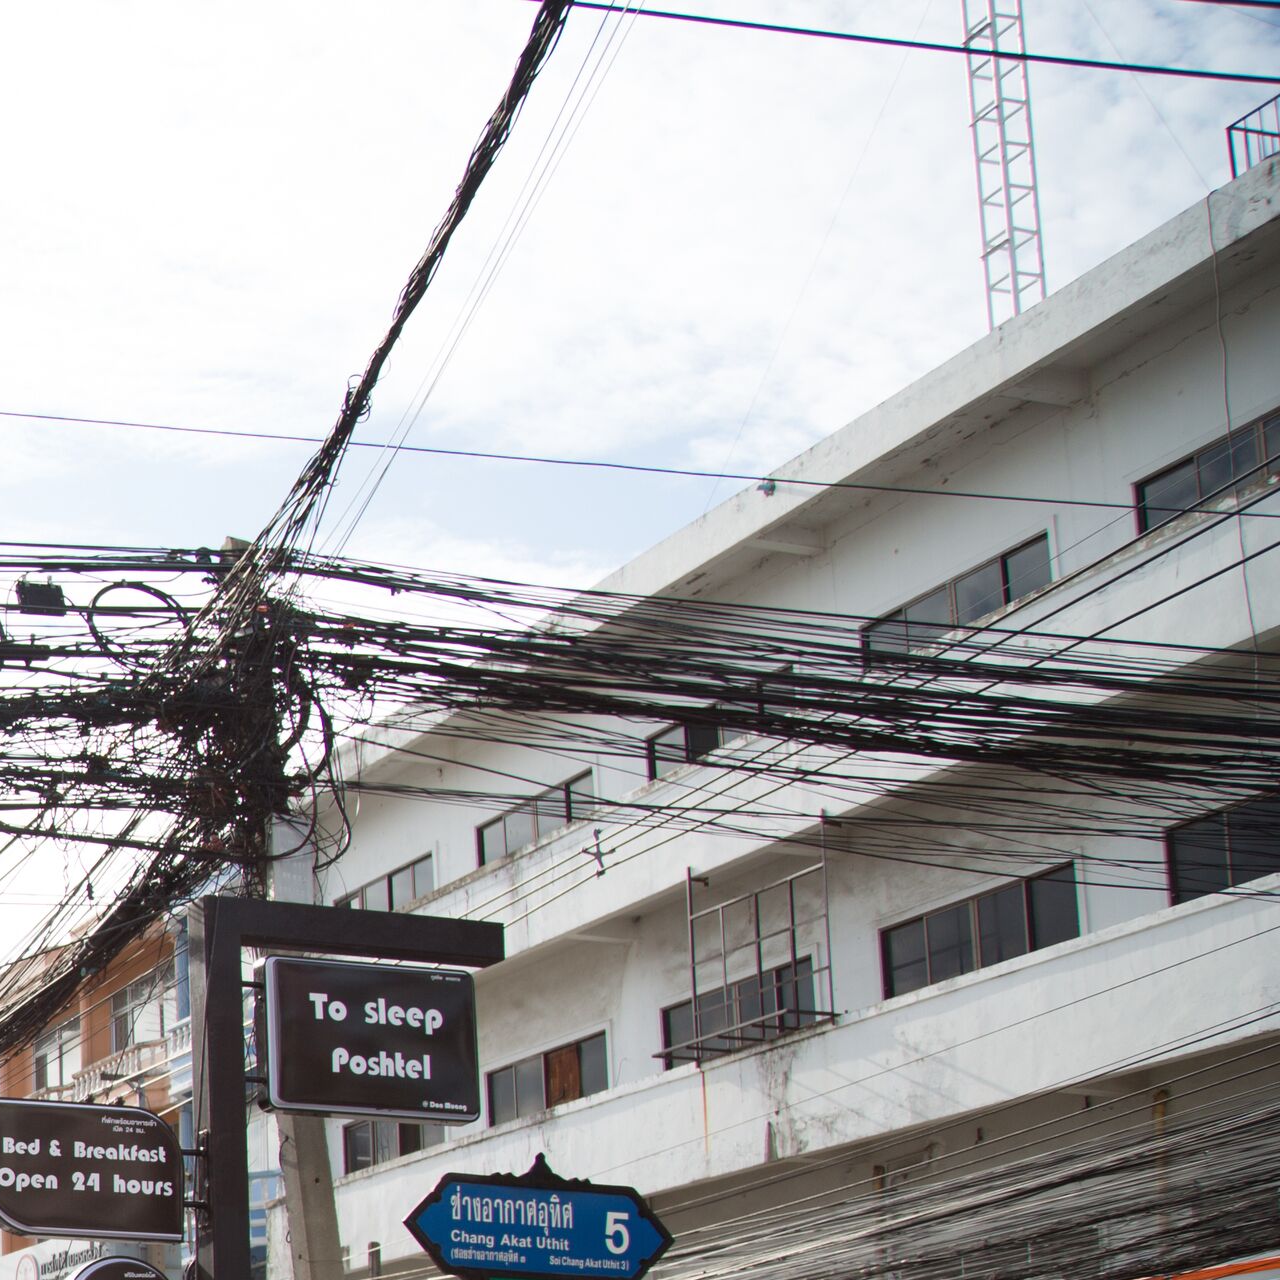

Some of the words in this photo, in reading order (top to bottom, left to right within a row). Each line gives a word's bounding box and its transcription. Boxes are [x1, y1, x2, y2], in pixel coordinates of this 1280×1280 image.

[309, 992, 348, 1022] To
[364, 997, 444, 1036] sleep
[331, 1047, 432, 1080] Poshtel
[3, 1137, 40, 1155] Bed
[49, 1139, 62, 1157] &
[74, 1141, 166, 1163] Breakfast
[72, 1171, 101, 1192] 24
[113, 1174, 173, 1196] hours
[450, 1186, 573, 1236] ช่างอากาศอุทิศ
[605, 1211, 630, 1255] 5
[450, 1229, 495, 1247] Chang
[500, 1234, 532, 1248] Akat
[536, 1237, 570, 1251] Uthit
[549, 1256, 561, 1265] Soi
[561, 1258, 584, 1269] Chang
[585, 1260, 602, 1269] Akat
[603, 1261, 619, 1270] Uthit
[620, 1262, 630, 1271] 3)
